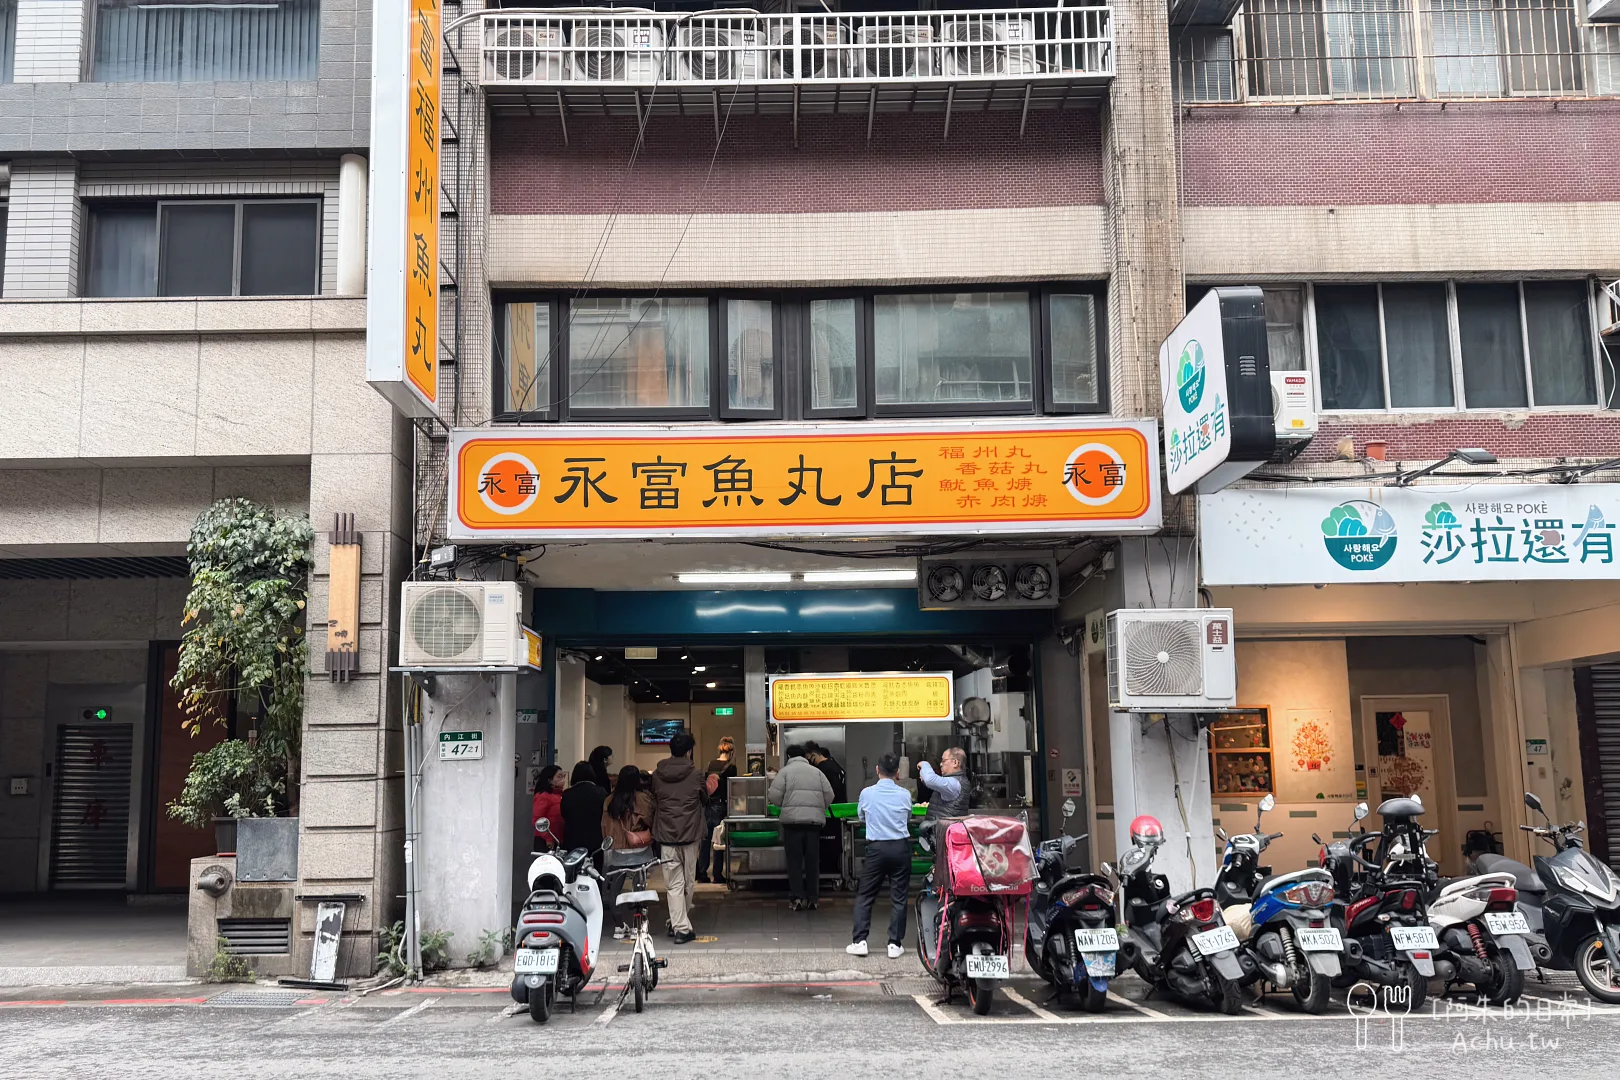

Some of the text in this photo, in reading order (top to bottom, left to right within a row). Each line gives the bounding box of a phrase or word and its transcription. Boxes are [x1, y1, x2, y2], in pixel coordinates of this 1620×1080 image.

[415, 0, 437, 373] 富福州魚丸
[938, 445, 1032, 460] 福州丸
[955, 460, 1048, 476] 香菇丸
[1061, 461, 1127, 488] 永富
[477, 471, 540, 496] 永富
[553, 450, 925, 510] 永富魚丸店
[1420, 505, 1616, 565] 沙拉還有
[1343, 543, 1380, 553] 사랑해요
[1211, 622, 1224, 644] 萬士益
[522, 714, 531, 722] 47
[1533, 745, 1542, 753] 47
[1077, 933, 1117, 947] NAW-1205
[968, 960, 1007, 973] EMU-2996
